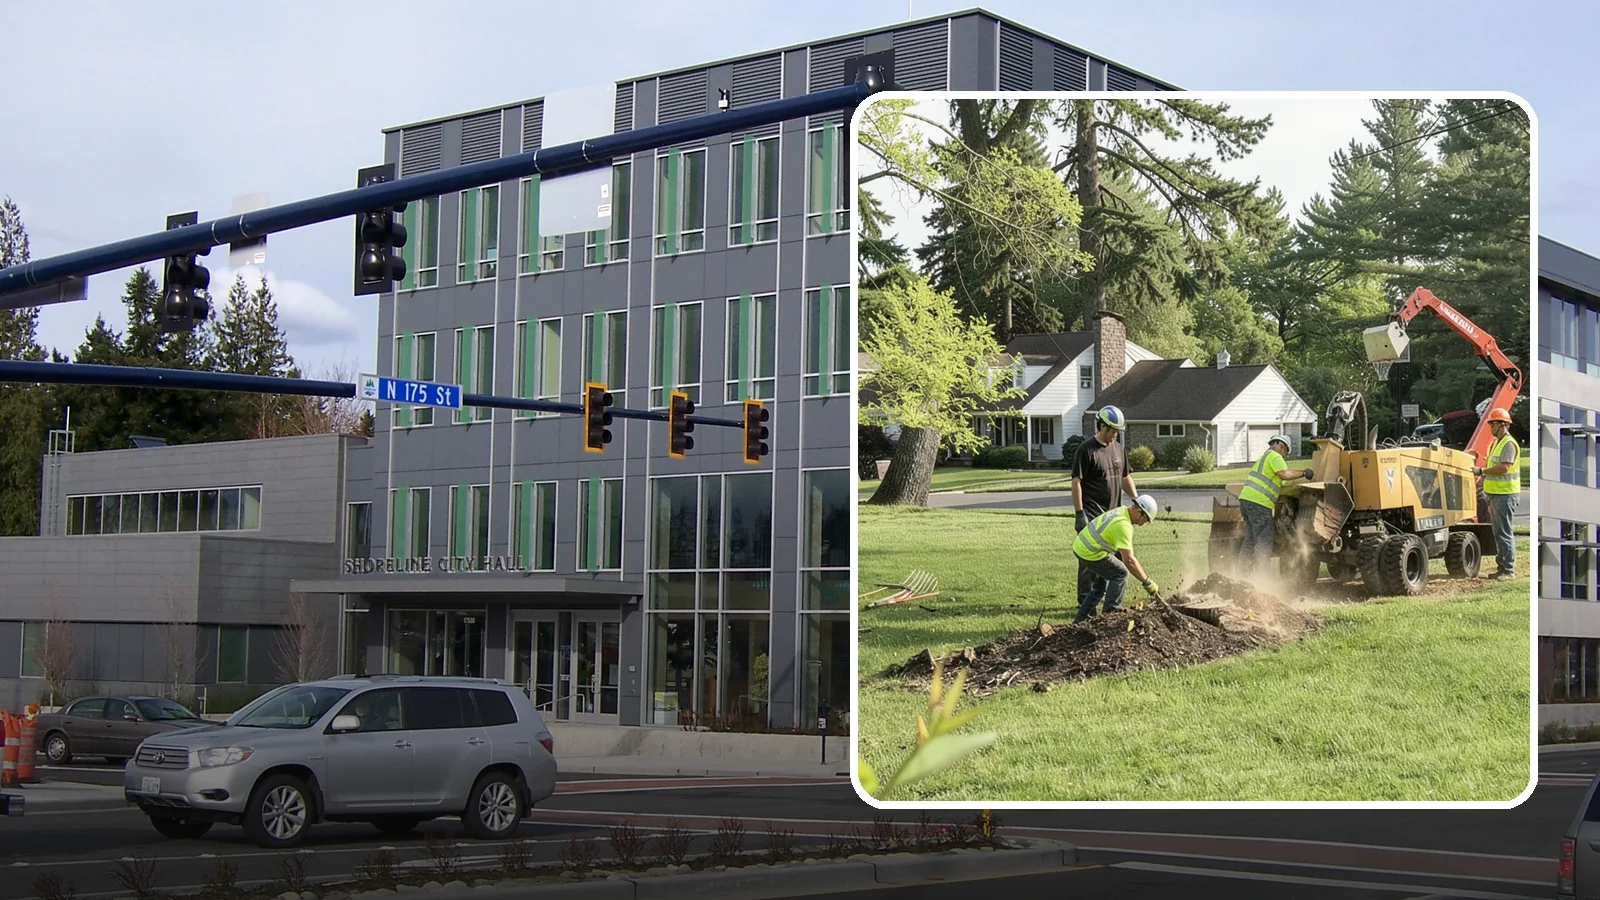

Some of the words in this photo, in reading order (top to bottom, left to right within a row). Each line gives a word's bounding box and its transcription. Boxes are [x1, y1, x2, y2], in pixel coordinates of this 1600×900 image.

[387, 380, 396, 399] N
[405, 382, 427, 403] 175
[436, 386, 451, 406] St
[344, 556, 432, 574] SHORELINE
[438, 556, 475, 572] CITY
[483, 555, 525, 571] HALL
